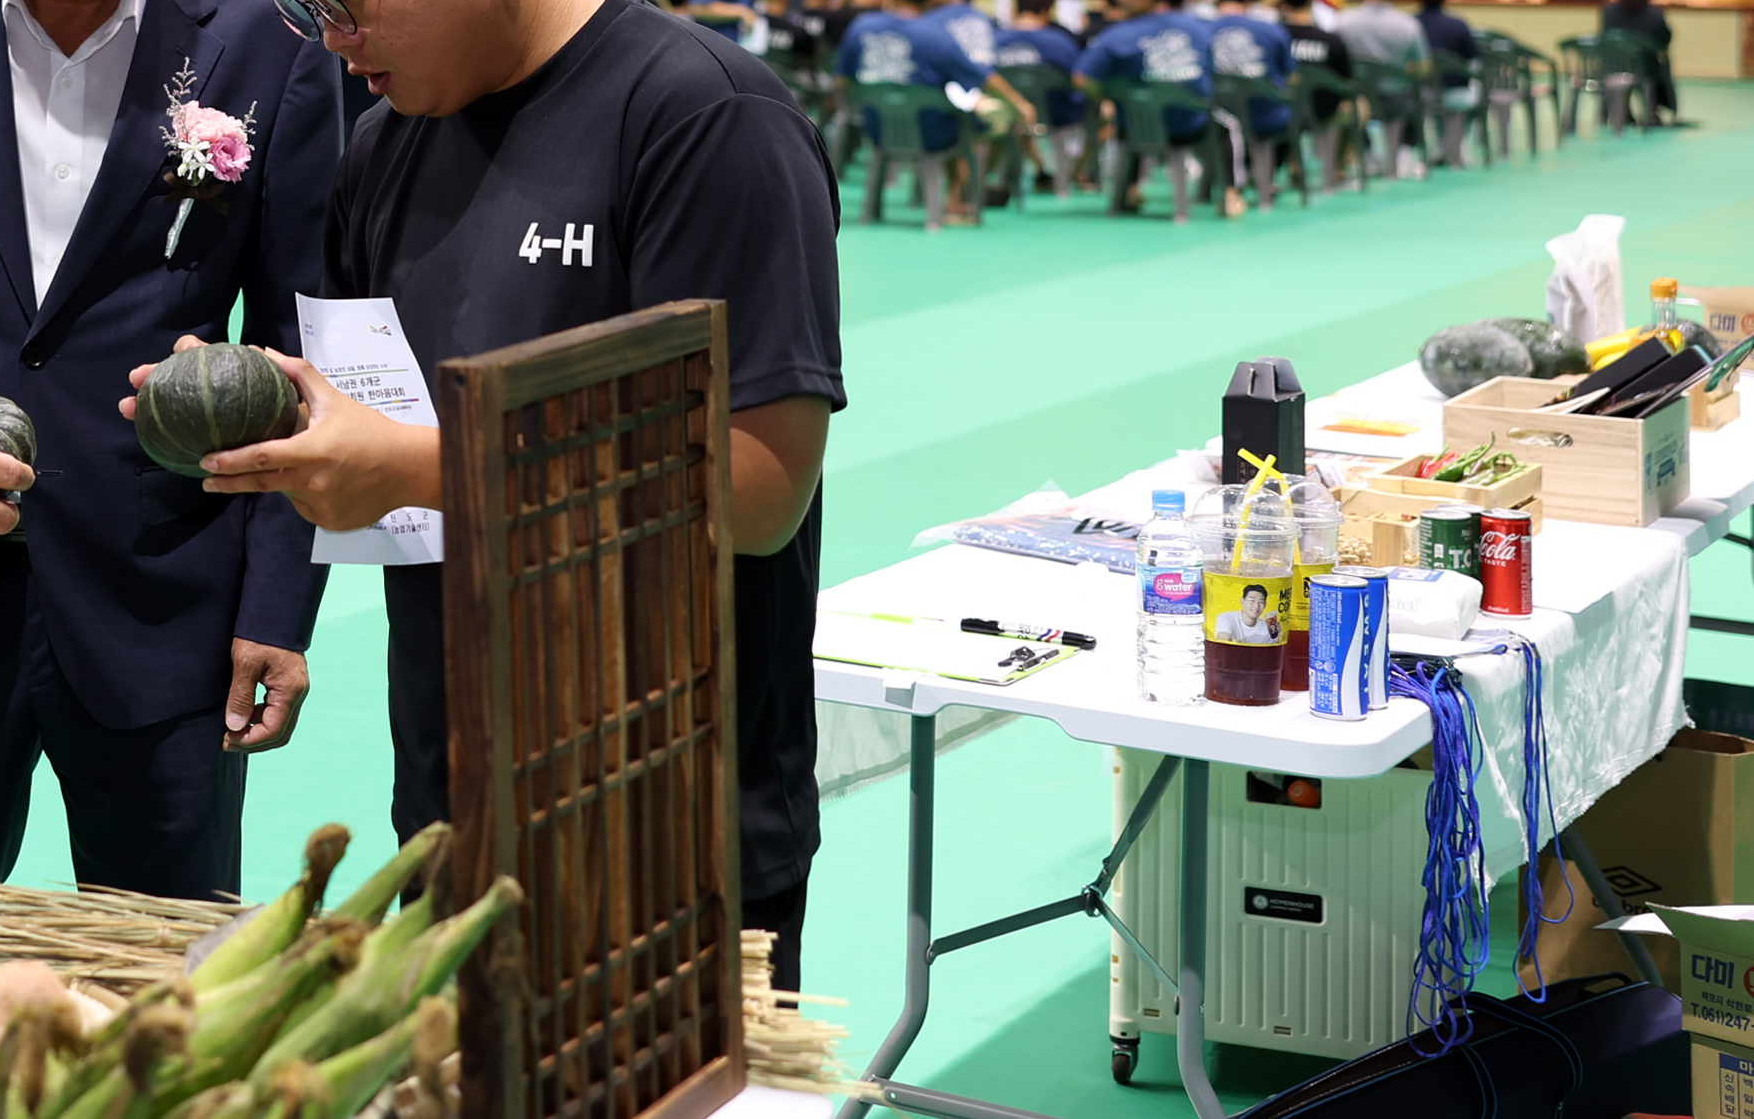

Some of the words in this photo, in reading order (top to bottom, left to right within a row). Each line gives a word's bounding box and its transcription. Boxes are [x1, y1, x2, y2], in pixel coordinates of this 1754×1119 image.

[518, 222, 594, 267] 4-H
[335, 378, 357, 390] 서남권
[360, 376, 382, 387] 6개군
[368, 387, 406, 401] 한마음대회
[1479, 530, 1521, 560] Cola
[1164, 583, 1193, 592] water
[1691, 953, 1735, 989] 다미
